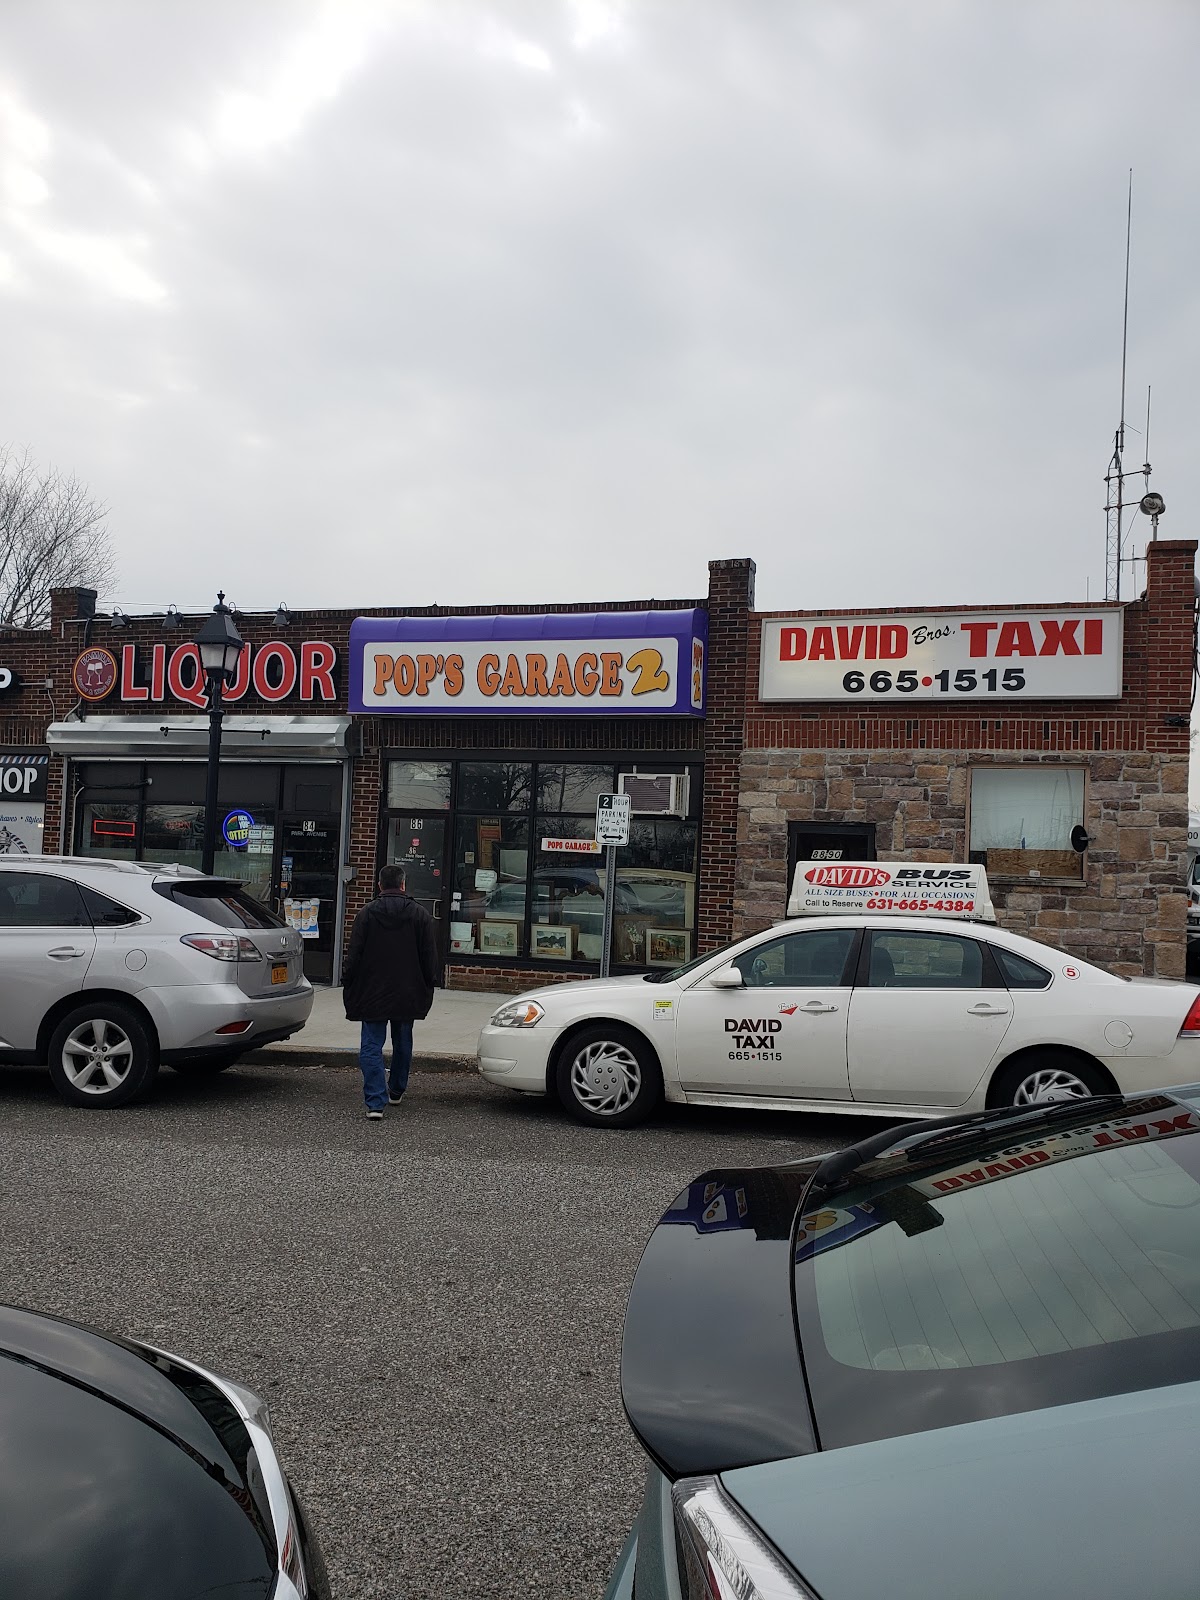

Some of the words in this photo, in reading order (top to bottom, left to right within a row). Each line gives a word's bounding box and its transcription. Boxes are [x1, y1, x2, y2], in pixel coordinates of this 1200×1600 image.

[780, 625, 909, 661] DAVID
[912, 625, 955, 645] Bros.
[960, 619, 1103, 658] TAXI
[121, 641, 337, 709] LIQUOR
[373, 653, 464, 696] POP'S
[476, 652, 623, 697] GARAGE
[626, 648, 669, 695] 2
[602, 797, 610, 807] 2
[613, 798, 628, 806] HOUR
[601, 810, 627, 818] PARKING
[304, 821, 314, 831] 84
[411, 819, 422, 828] 86
[599, 825, 610, 833] MON
[564, 842, 591, 850] GARAGE
[895, 869, 971, 880] BUS
[891, 880, 977, 889] SERVICE
[824, 889, 844, 897] SIZE
[805, 899, 820, 907] Call
[866, 899, 974, 912] 631-665-4384
[1066, 967, 1076, 977] 5
[724, 1018, 782, 1032] DAVID
[732, 1035, 775, 1049] TAXI
